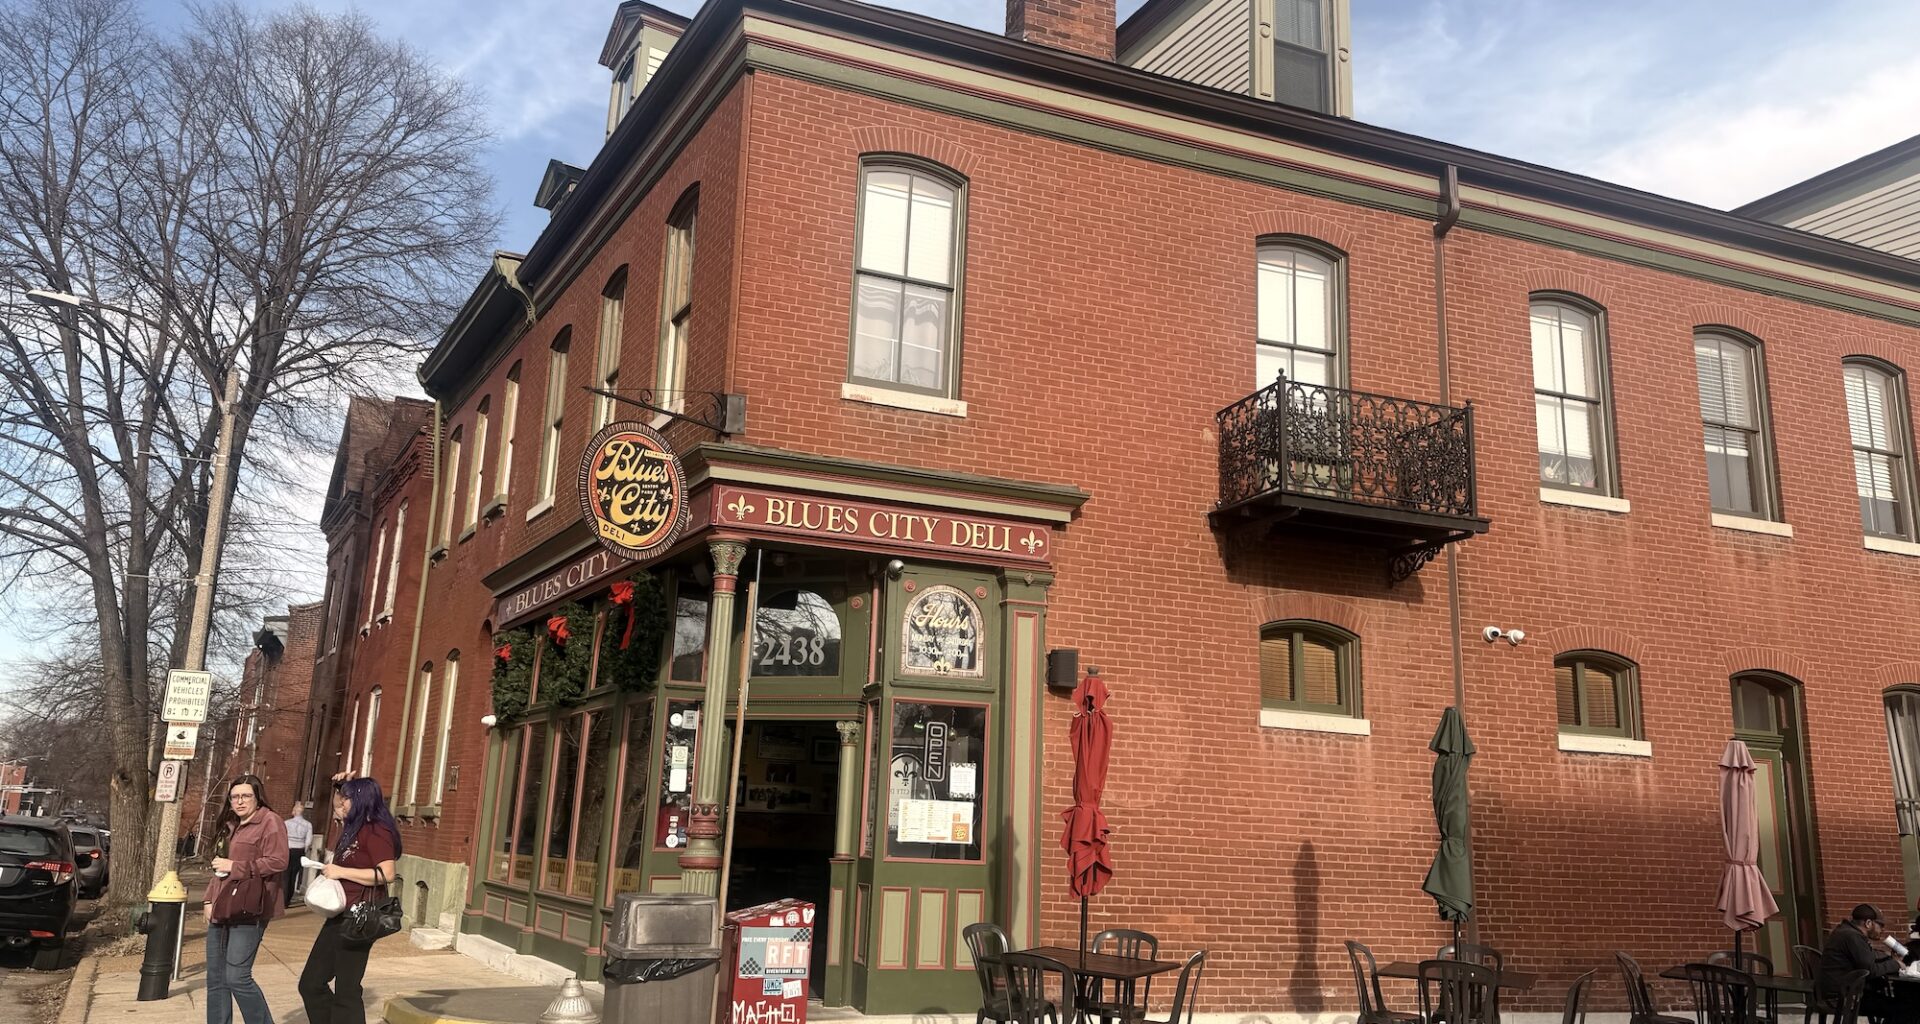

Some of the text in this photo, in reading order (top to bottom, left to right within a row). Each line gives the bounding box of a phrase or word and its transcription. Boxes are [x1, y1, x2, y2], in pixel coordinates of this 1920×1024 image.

[595, 440, 669, 483] Blues
[610, 482, 670, 525] City
[602, 523, 626, 541] DELI
[765, 497, 1012, 551] BLUES CITY DELI
[515, 551, 612, 614] BLUES CITY
[915, 603, 969, 630] Hours
[759, 637, 825, 666] 2438
[172, 675, 207, 684] COMMERCIAL
[173, 686, 204, 695] VEHICLES
[168, 696, 205, 706] PROHIBITED
[928, 725, 943, 778] OPEN
[767, 944, 807, 965] RFT
